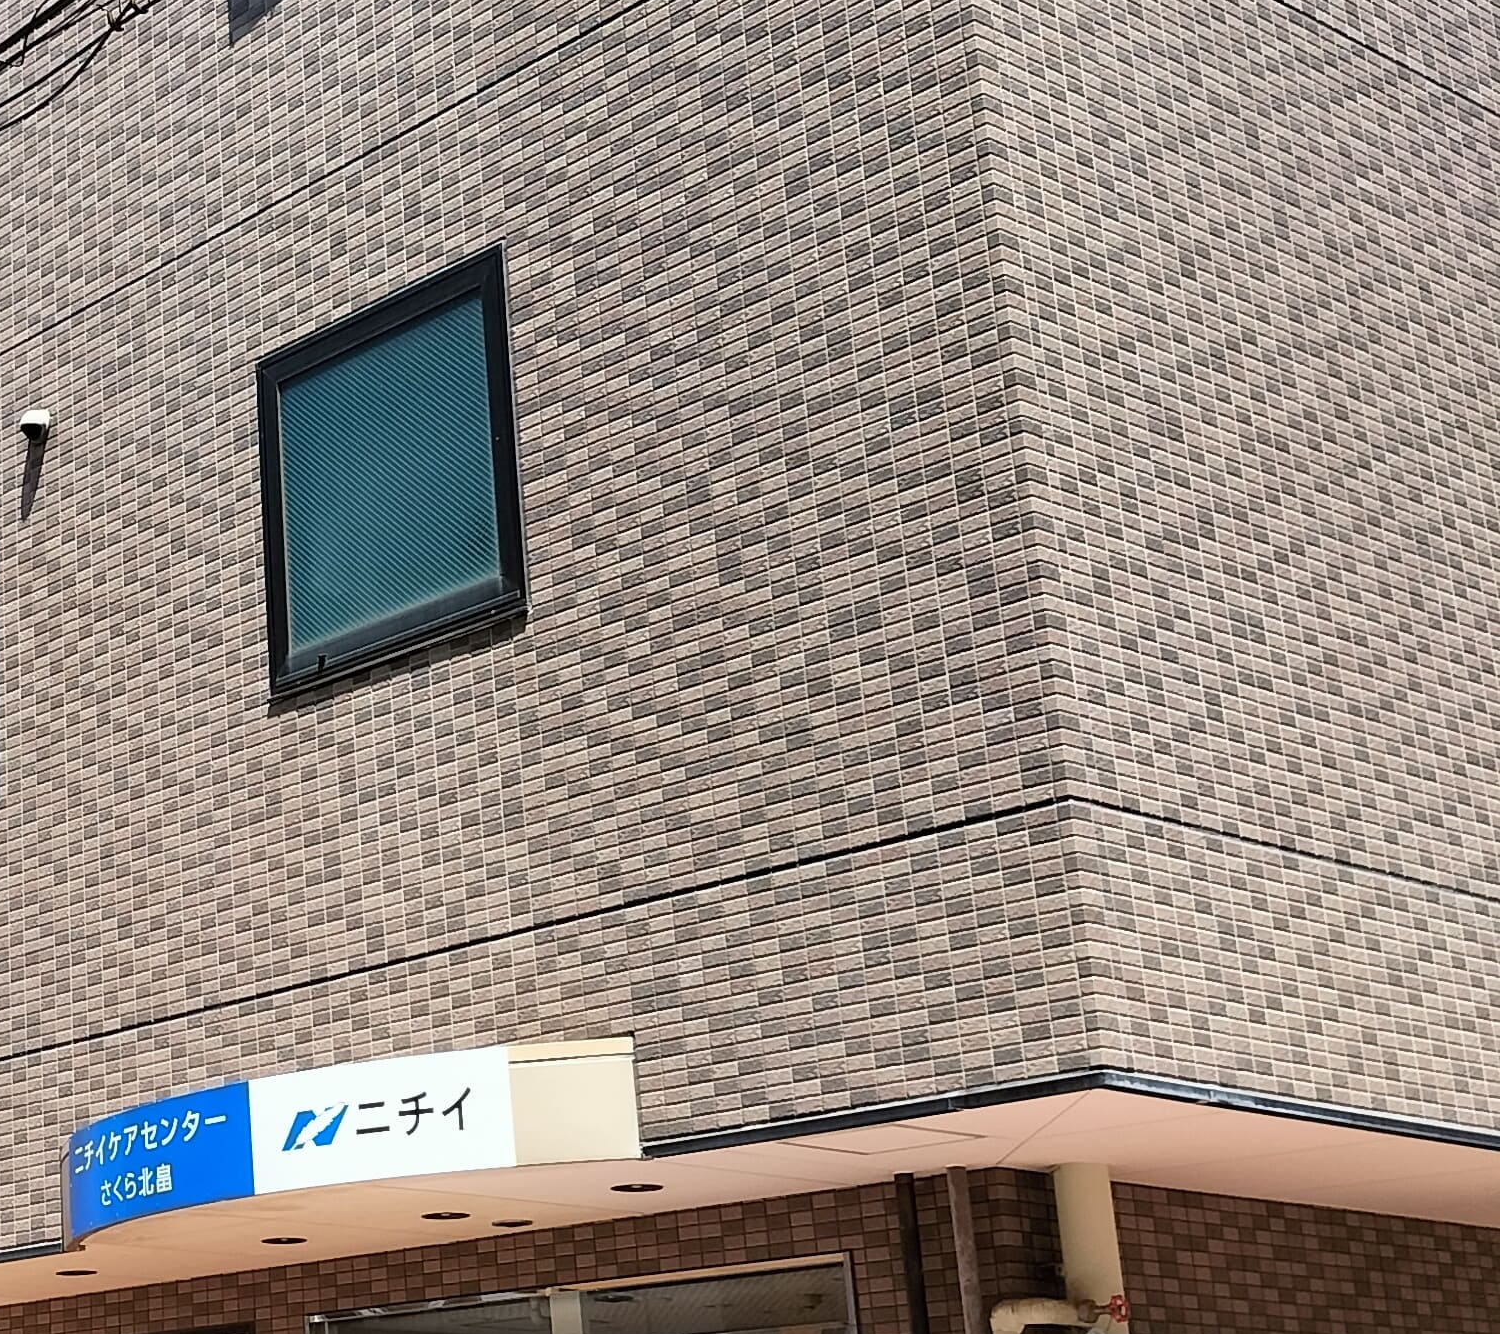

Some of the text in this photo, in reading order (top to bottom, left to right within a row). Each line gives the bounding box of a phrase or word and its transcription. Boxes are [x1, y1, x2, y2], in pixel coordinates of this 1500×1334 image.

[355, 1087, 472, 1136] ニチイ
[74, 1109, 227, 1174] ニチイケアセンター
[100, 1163, 173, 1206] さくら北畠
